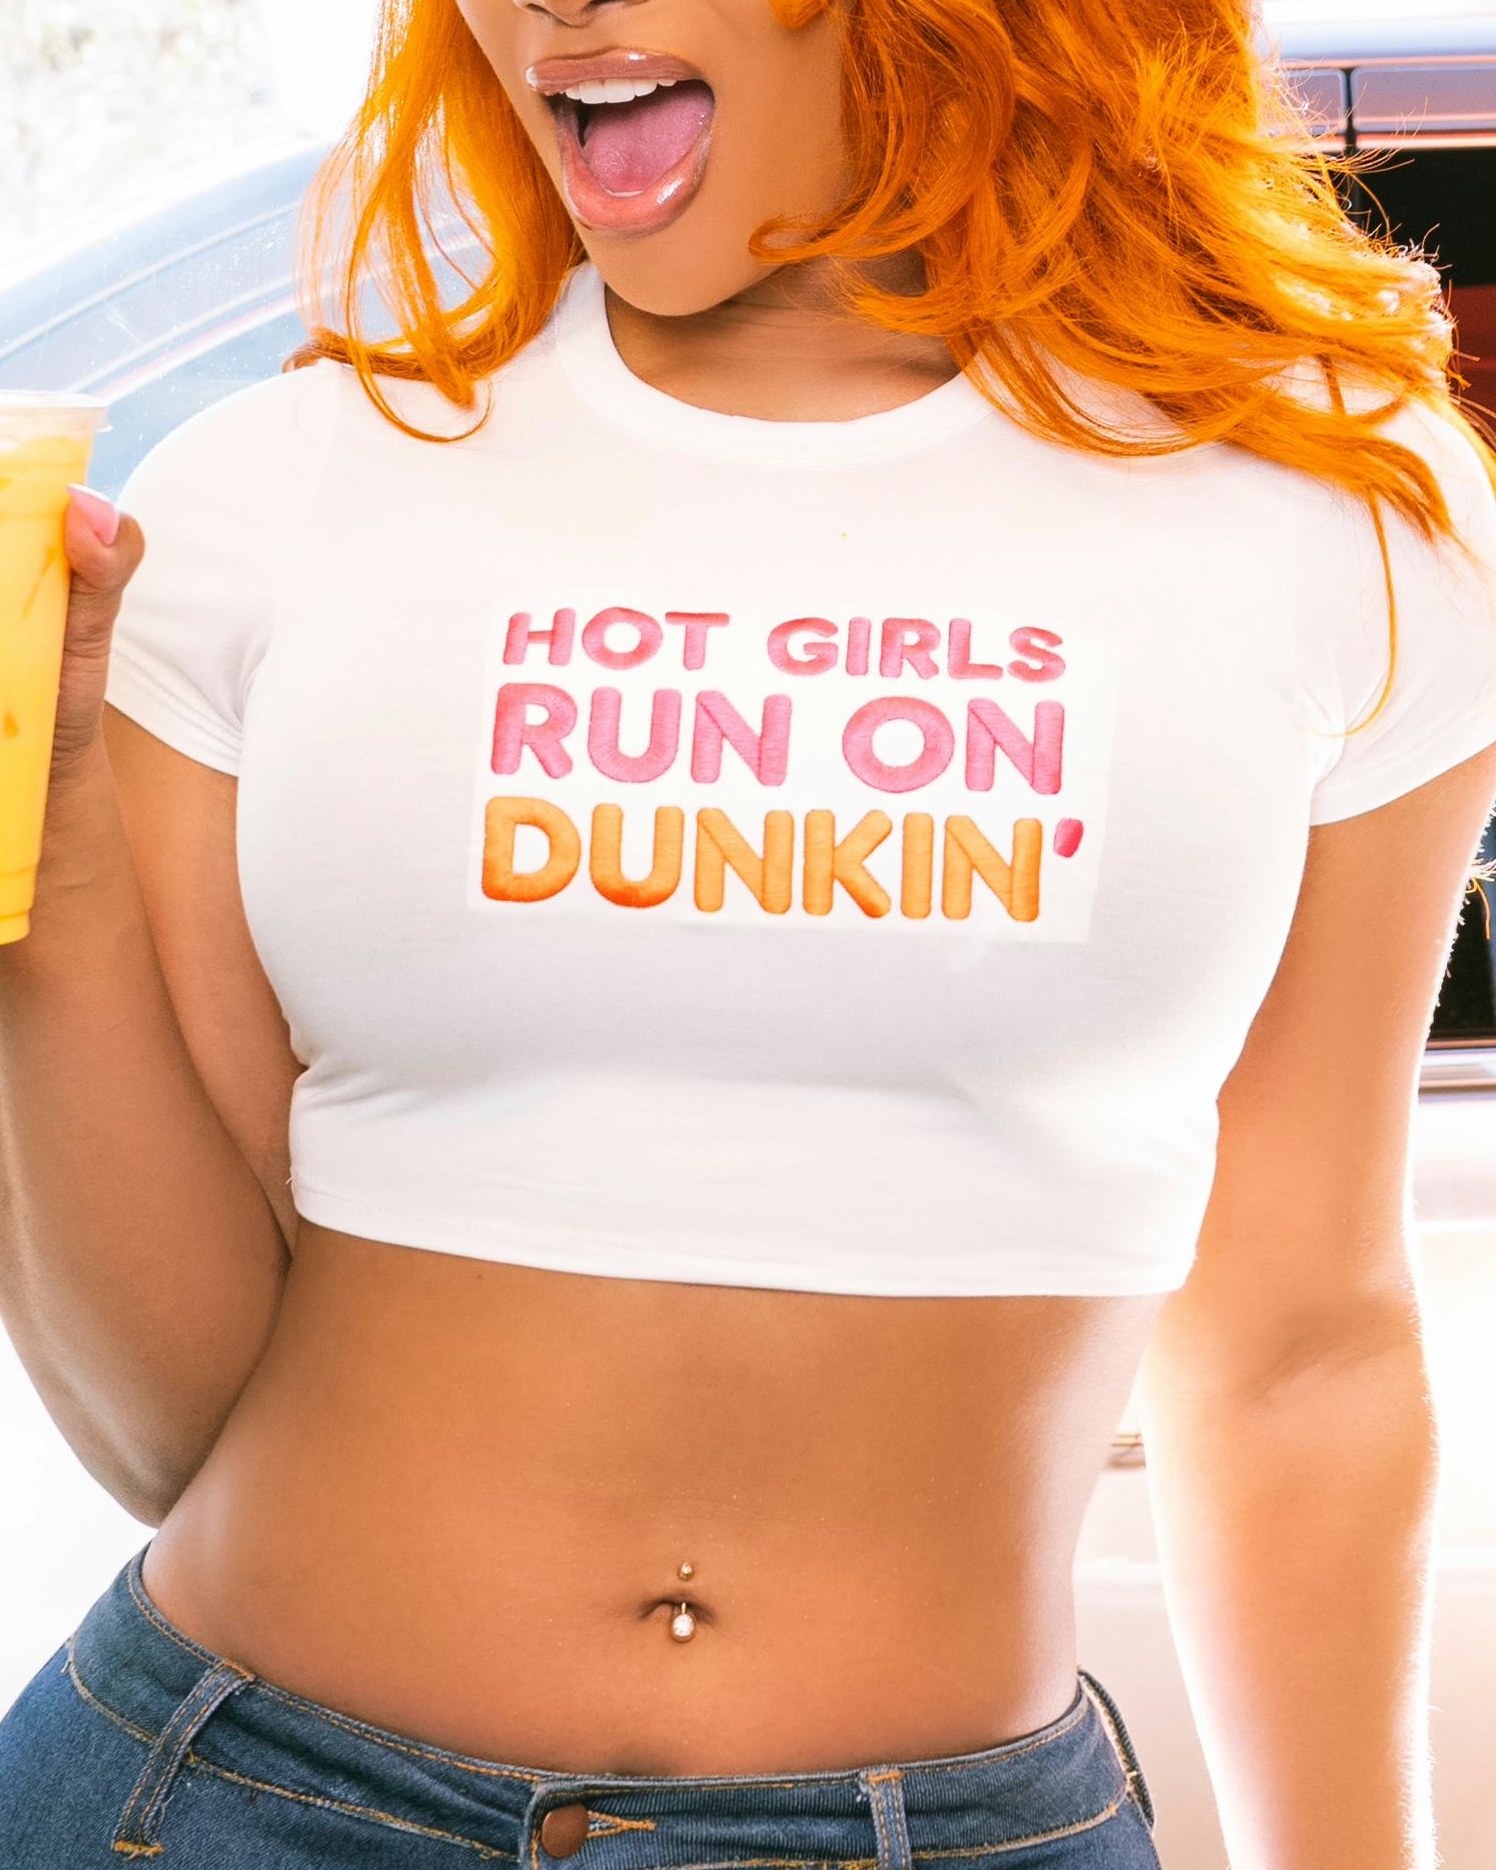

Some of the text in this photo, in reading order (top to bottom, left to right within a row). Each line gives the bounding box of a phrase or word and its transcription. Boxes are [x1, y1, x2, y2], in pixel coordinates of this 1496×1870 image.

[502, 606, 1066, 683] HOT GIRLS
[490, 681, 1065, 795] RUN ON
[481, 795, 1085, 923] DUNKIN'
